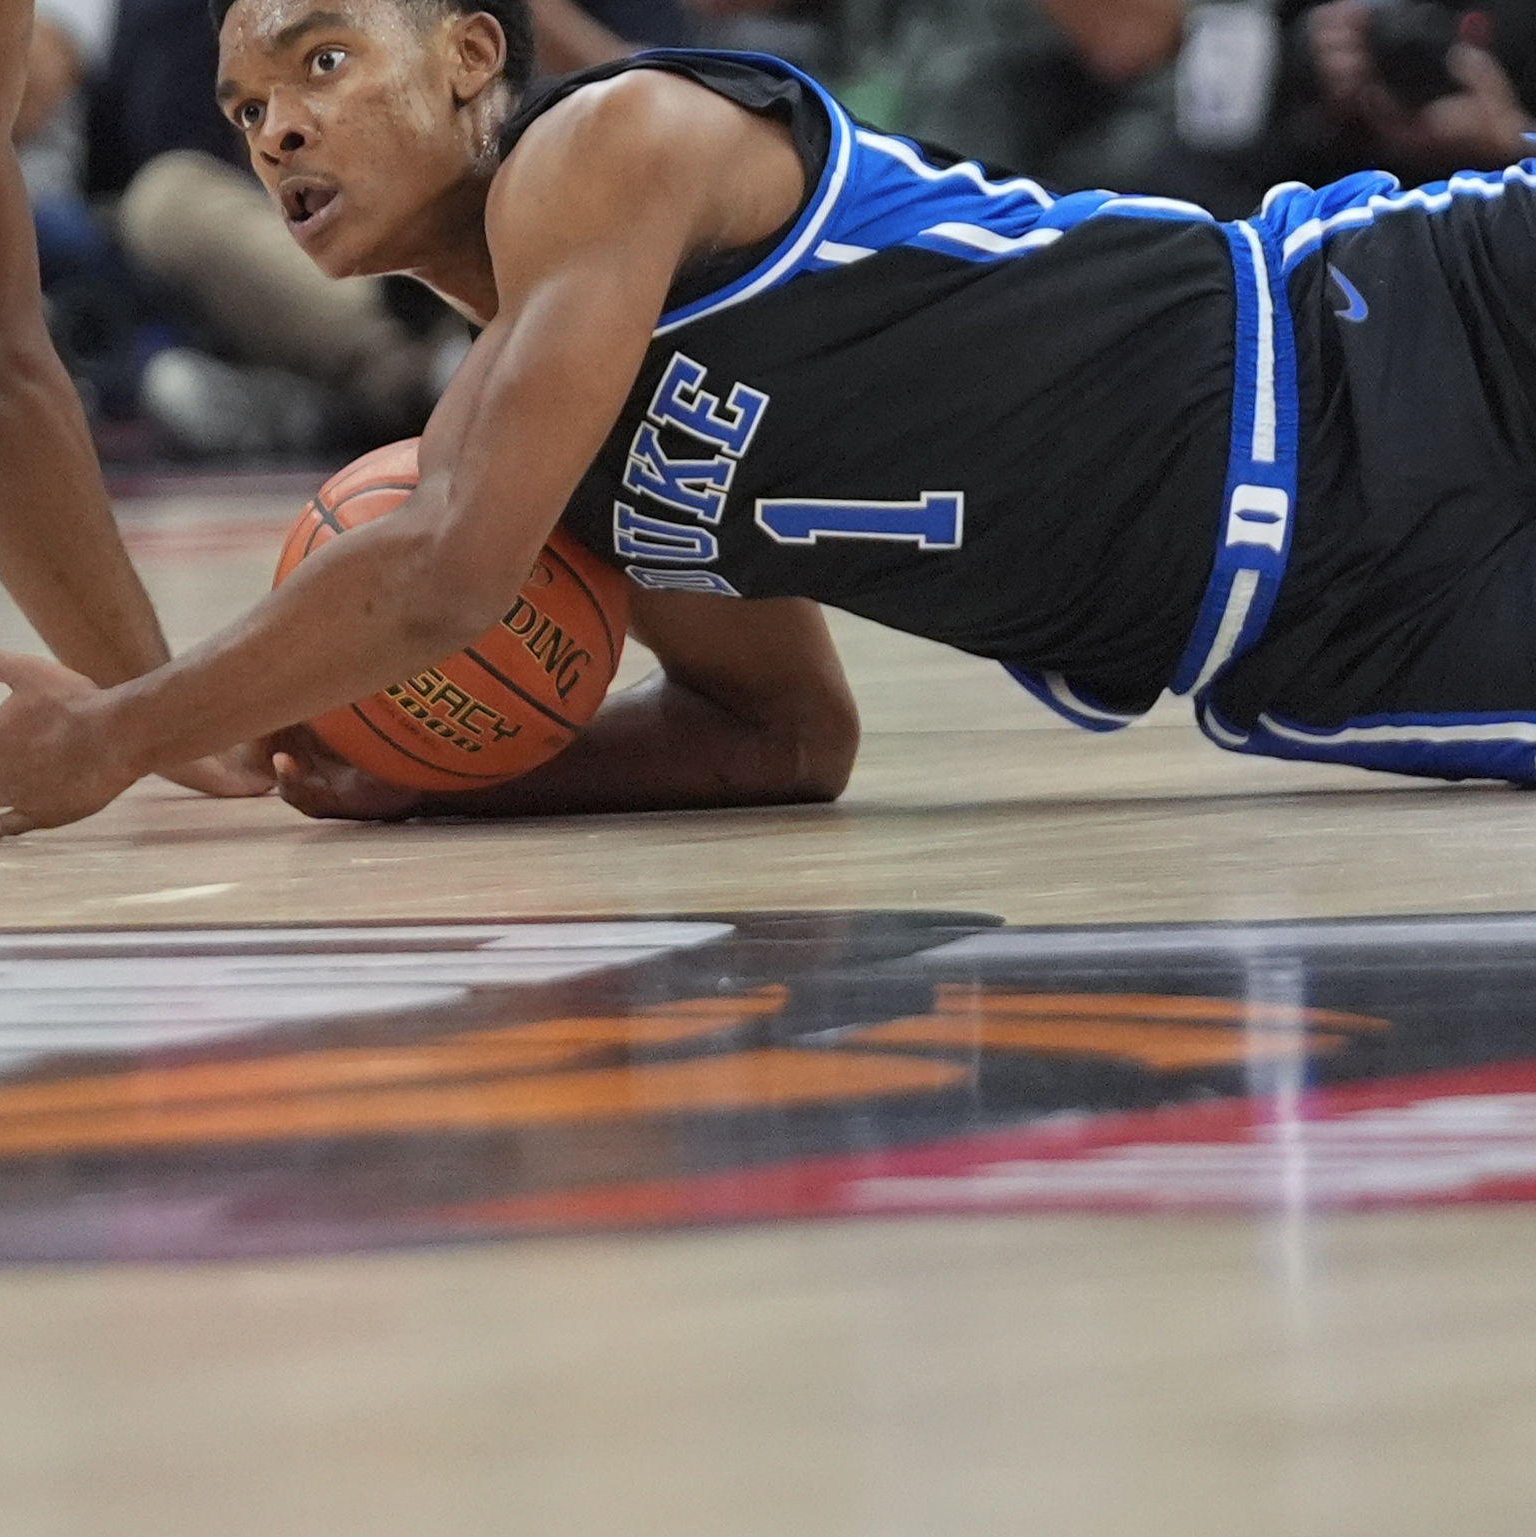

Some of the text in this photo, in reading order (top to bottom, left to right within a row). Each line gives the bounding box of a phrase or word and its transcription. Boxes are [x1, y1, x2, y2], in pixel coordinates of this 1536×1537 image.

[614, 350, 770, 597] DUKE
[755, 490, 964, 550] 1
[499, 592, 595, 701] DING
[404, 666, 524, 743] GACY
